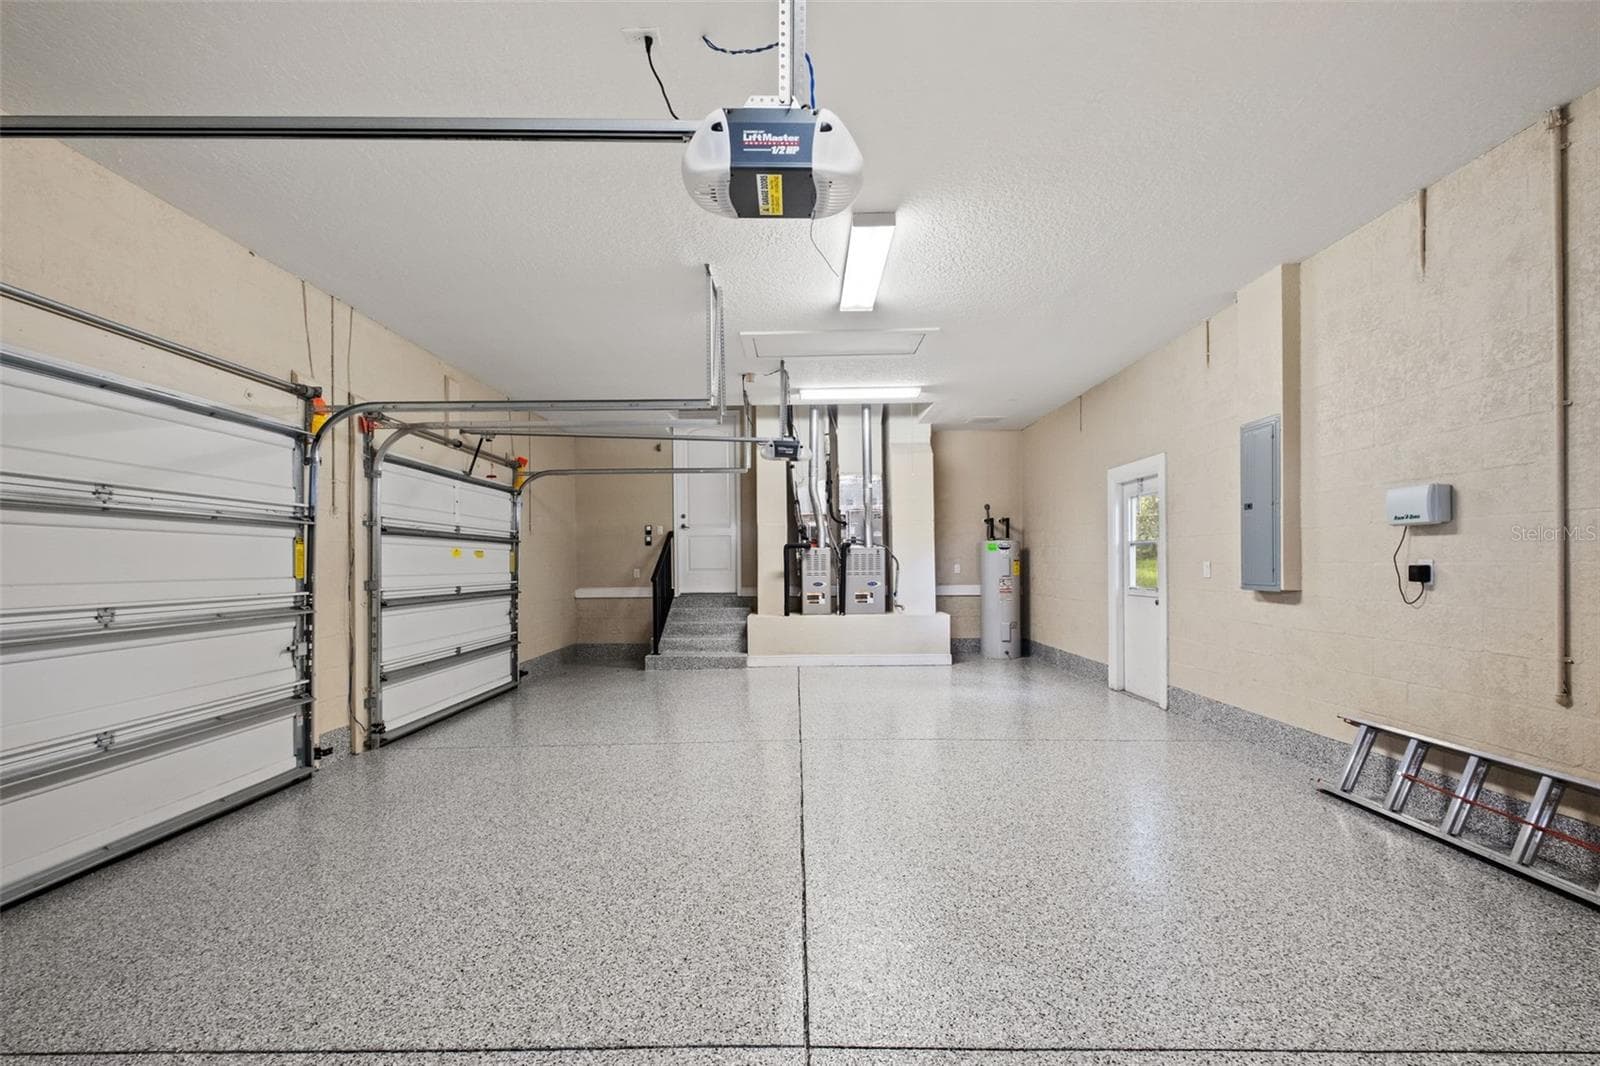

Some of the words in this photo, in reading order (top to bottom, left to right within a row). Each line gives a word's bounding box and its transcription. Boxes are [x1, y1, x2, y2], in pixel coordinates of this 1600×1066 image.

[743, 132, 800, 141] LiftMaster
[771, 145, 785, 154] 1/2
[760, 175, 769, 189] DOORS
